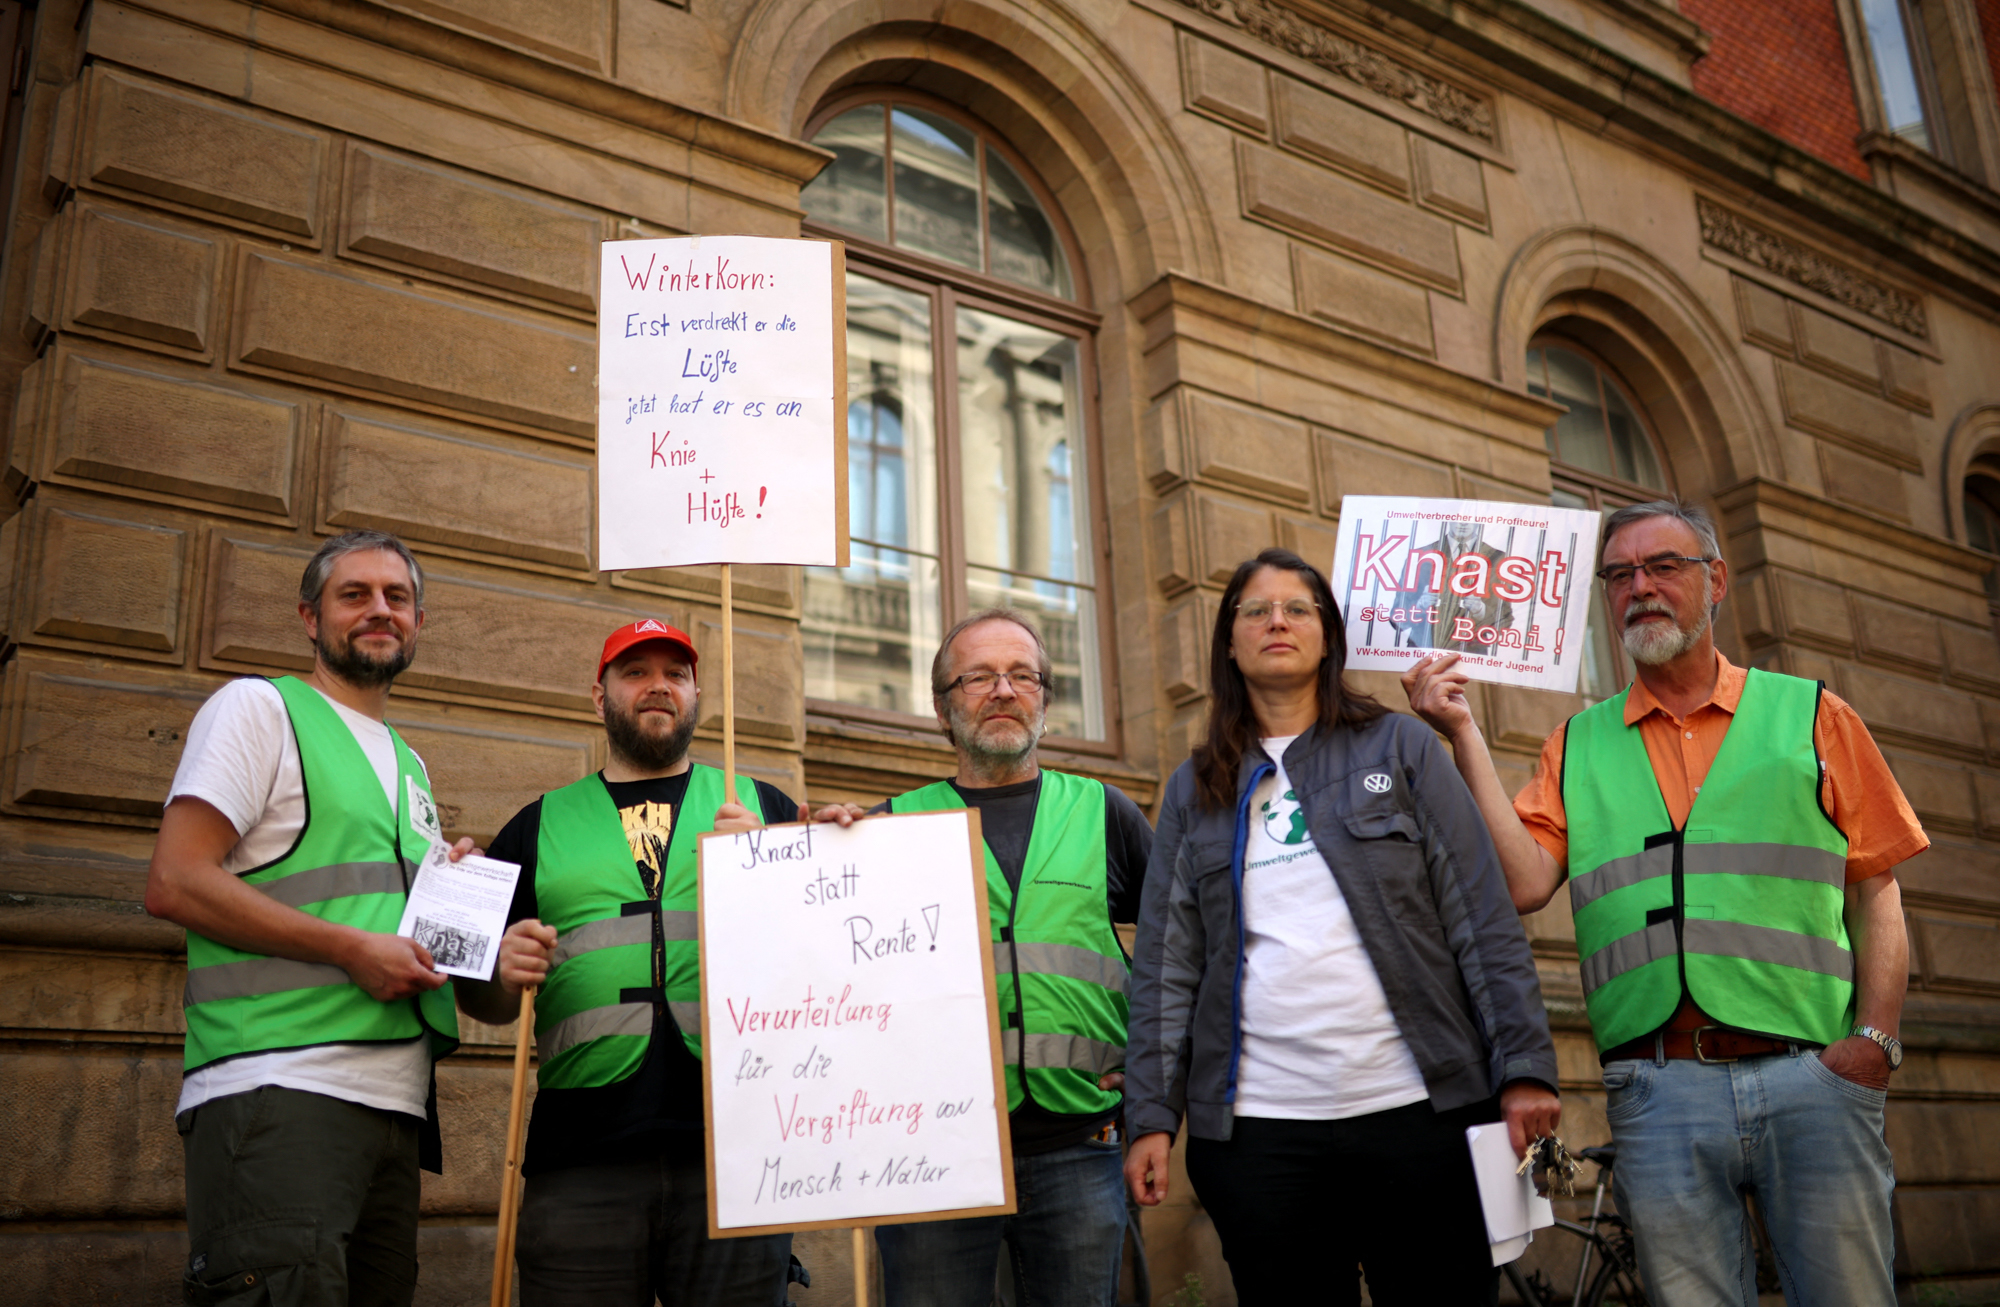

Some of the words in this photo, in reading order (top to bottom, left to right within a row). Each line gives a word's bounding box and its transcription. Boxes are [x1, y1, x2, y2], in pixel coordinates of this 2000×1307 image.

[624, 312, 670, 339] Erst
[754, 320, 768, 332] er
[775, 313, 797, 332] die
[681, 347, 738, 383] Lüfte
[625, 394, 657, 425] jetzt
[669, 390, 704, 414] hat
[712, 399, 735, 415] er
[742, 400, 766, 418] es
[775, 400, 803, 418] an
[650, 430, 697, 470] Knie
[1386, 510, 1472, 523] Umweltverbrecher
[1474, 515, 1494, 524] und
[1496, 516, 1549, 530] Profiteure!
[1351, 533, 1567, 609] Knast
[1360, 603, 1440, 625] statt
[1355, 647, 1411, 659] VW-Komitee
[1413, 648, 1426, 659] für
[1447, 652, 1484, 667] kunft
[1486, 658, 1503, 669] der
[1506, 661, 1544, 674] Jugend
[735, 822, 818, 870] Knast
[1243, 846, 1318, 873] Umweltgewe
[804, 863, 861, 906] statt
[413, 921, 487, 958] Knast
[726, 983, 892, 1037] Verurteilung
[735, 1048, 773, 1086] für
[792, 1045, 832, 1080] die
[774, 1088, 924, 1145] Vergiftung
[754, 1156, 842, 1205] Mensch
[876, 1155, 951, 1188] Natur
